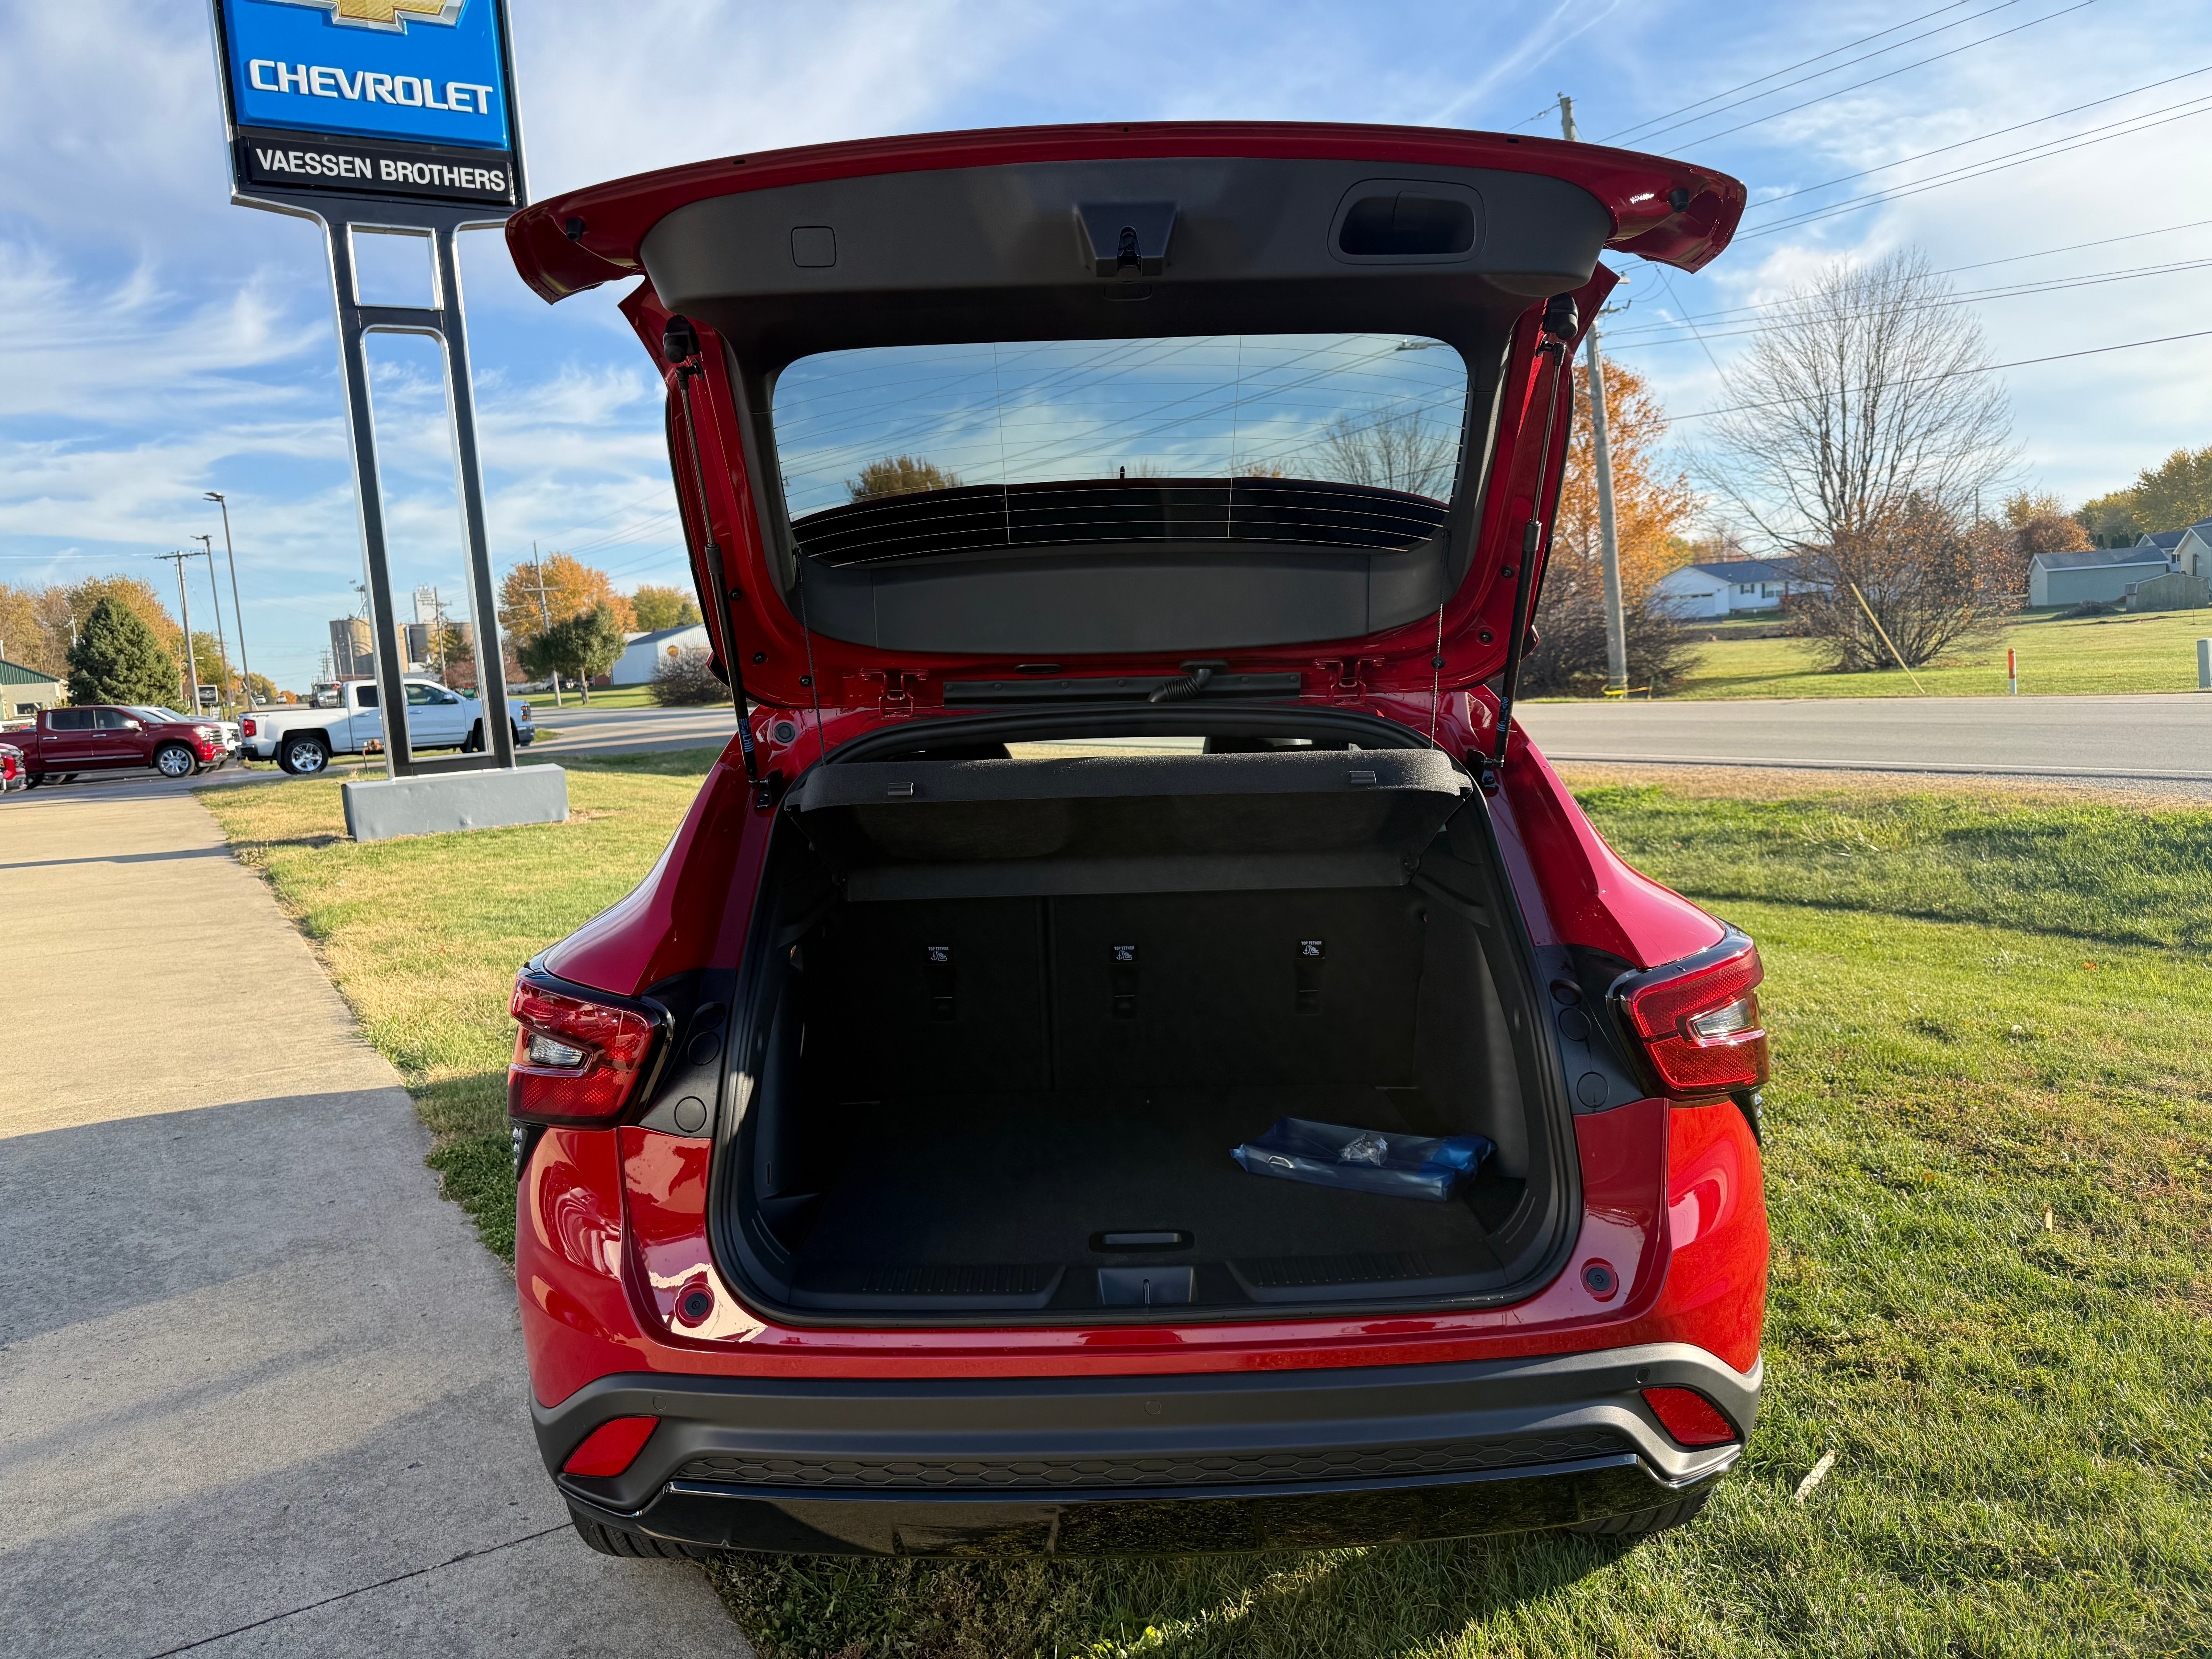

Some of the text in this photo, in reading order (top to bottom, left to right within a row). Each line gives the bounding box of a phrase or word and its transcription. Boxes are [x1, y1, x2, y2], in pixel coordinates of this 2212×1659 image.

[249, 59, 493, 115] CHEVROLET
[256, 148, 505, 192] VAESSEN BROTHERS
